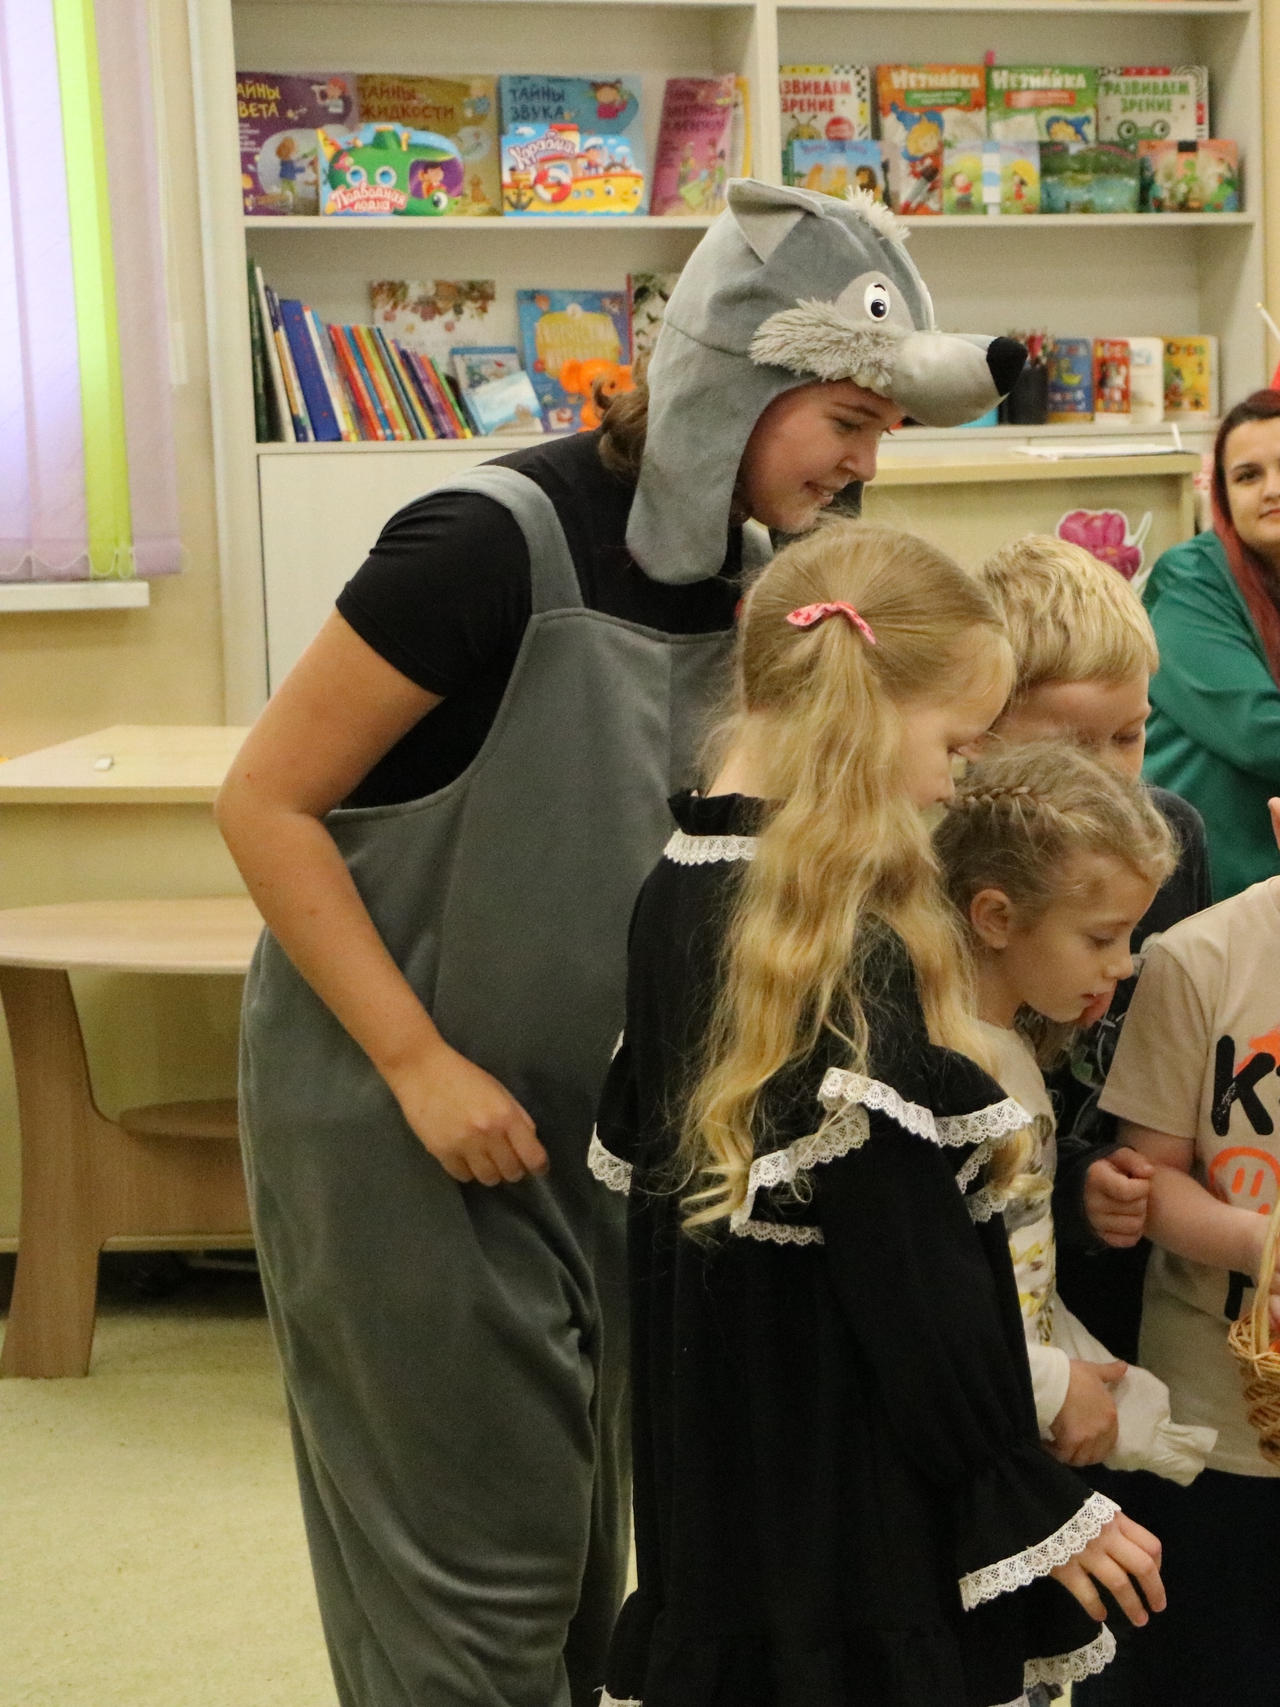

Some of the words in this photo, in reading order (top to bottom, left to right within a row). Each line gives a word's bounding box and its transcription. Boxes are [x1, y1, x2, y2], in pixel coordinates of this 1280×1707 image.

[236, 80, 281, 100] АЙНЫ
[509, 84, 566, 102] ТАЙНЫ
[781, 79, 852, 95] ЗВИВАЕМ
[1103, 80, 1190, 96] РАЗВИВАЕМ
[237, 101, 280, 119] ВЕТА
[510, 104, 564, 121] ЗВУКА
[781, 98, 835, 113] ЗРЕНИЕ
[1120, 98, 1173, 113] ЗРЕНИЕ
